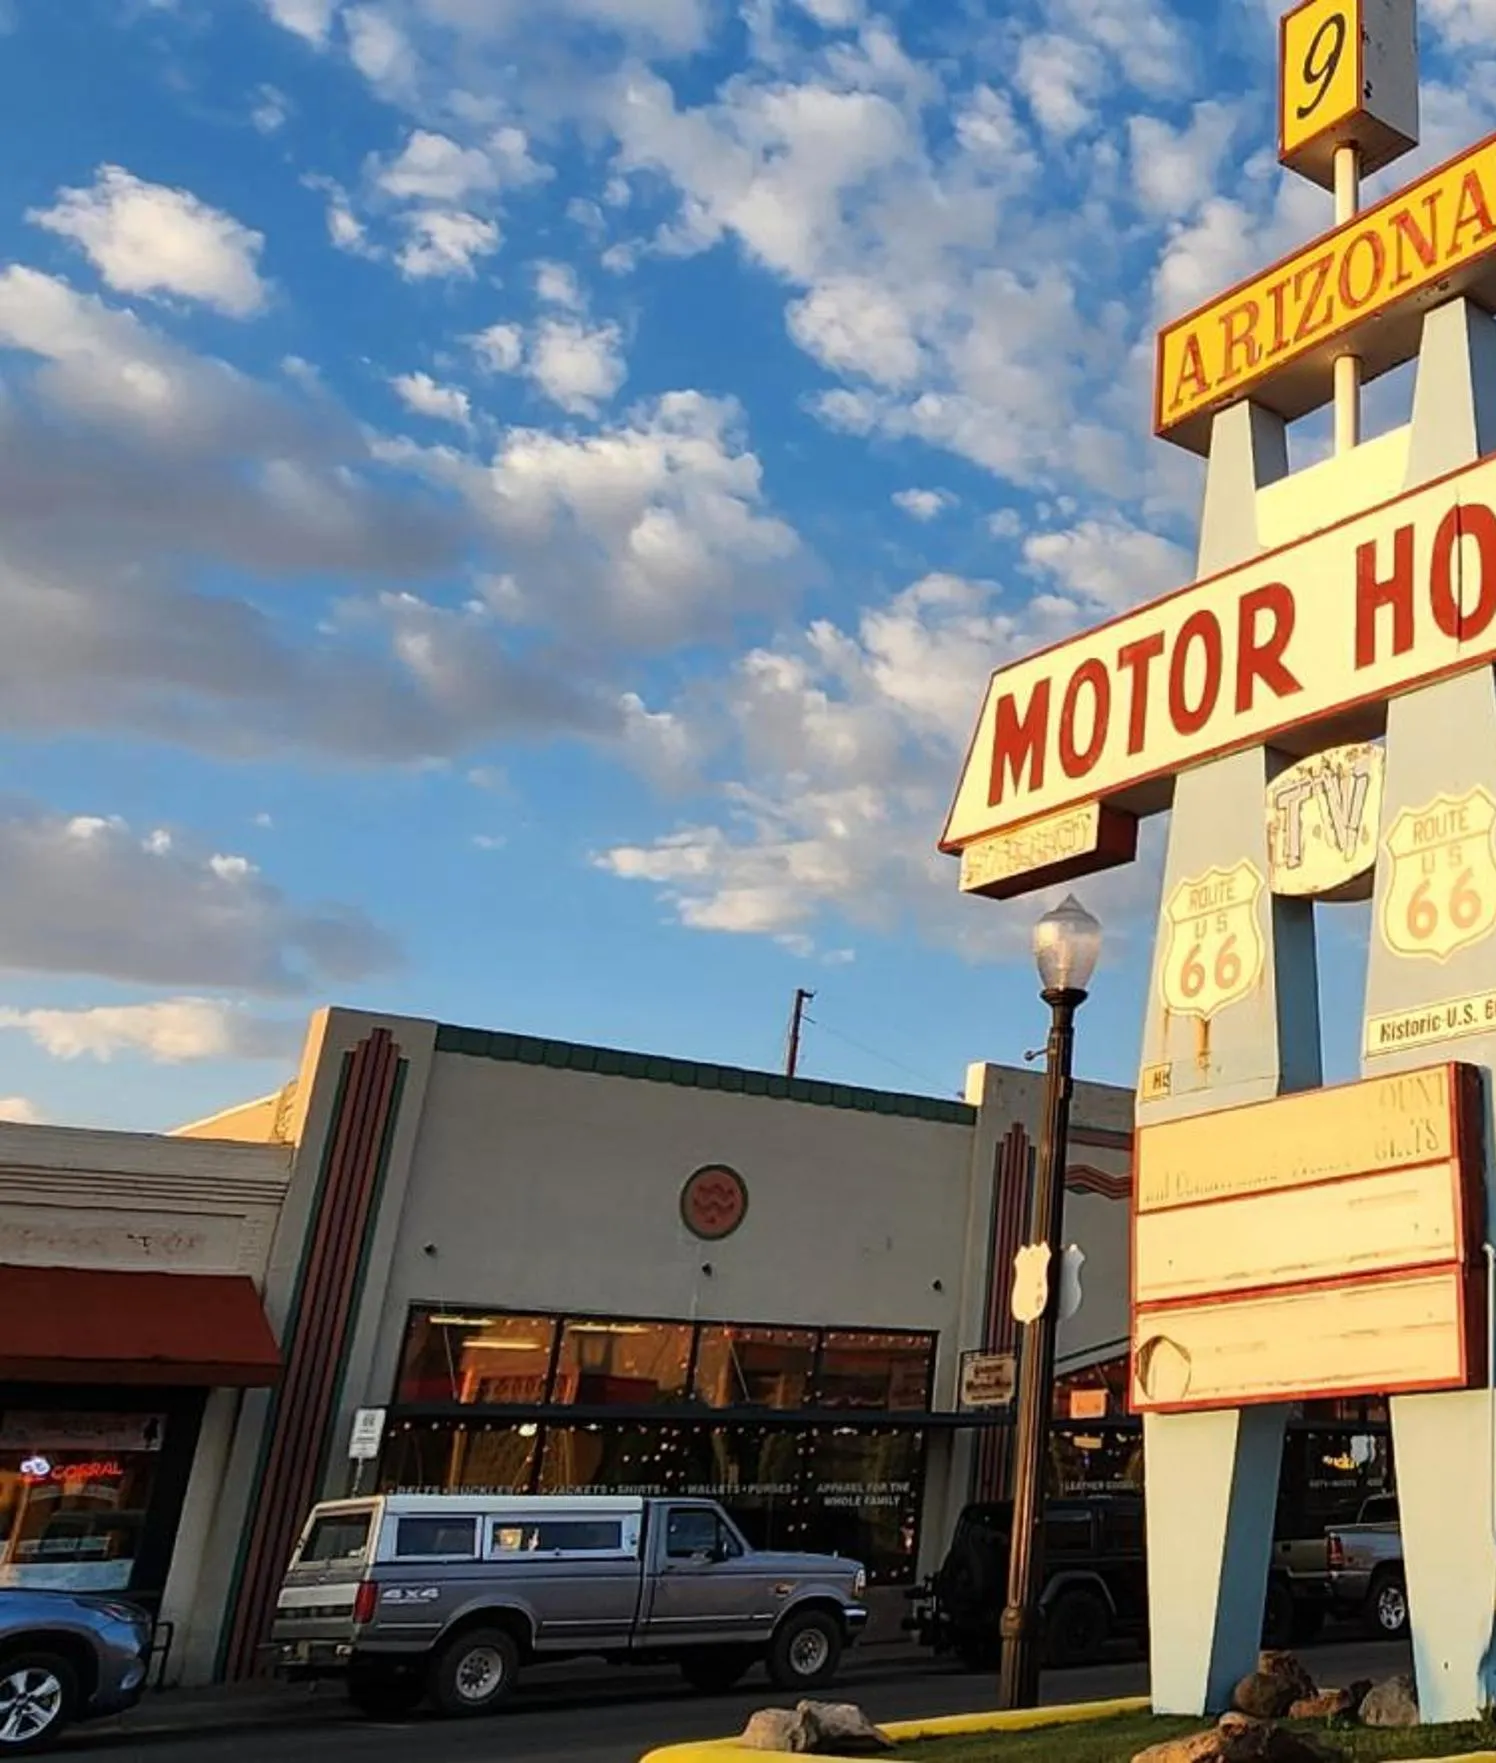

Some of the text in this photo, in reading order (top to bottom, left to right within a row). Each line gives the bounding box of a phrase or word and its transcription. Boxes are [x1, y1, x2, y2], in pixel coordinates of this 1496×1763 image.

[1295, 11, 1347, 120] 9
[986, 582, 1303, 806] MOTOR
[1275, 766, 1370, 870] TV
[1413, 804, 1469, 845] ROUTE
[1189, 877, 1237, 912] ROUTE
[1406, 866, 1483, 940] 66
[1180, 932, 1242, 998] 66
[1379, 1013, 1441, 1043] Historic
[1446, 1003, 1478, 1029] U.S.
[687, 1483, 740, 1495] WALLETS
